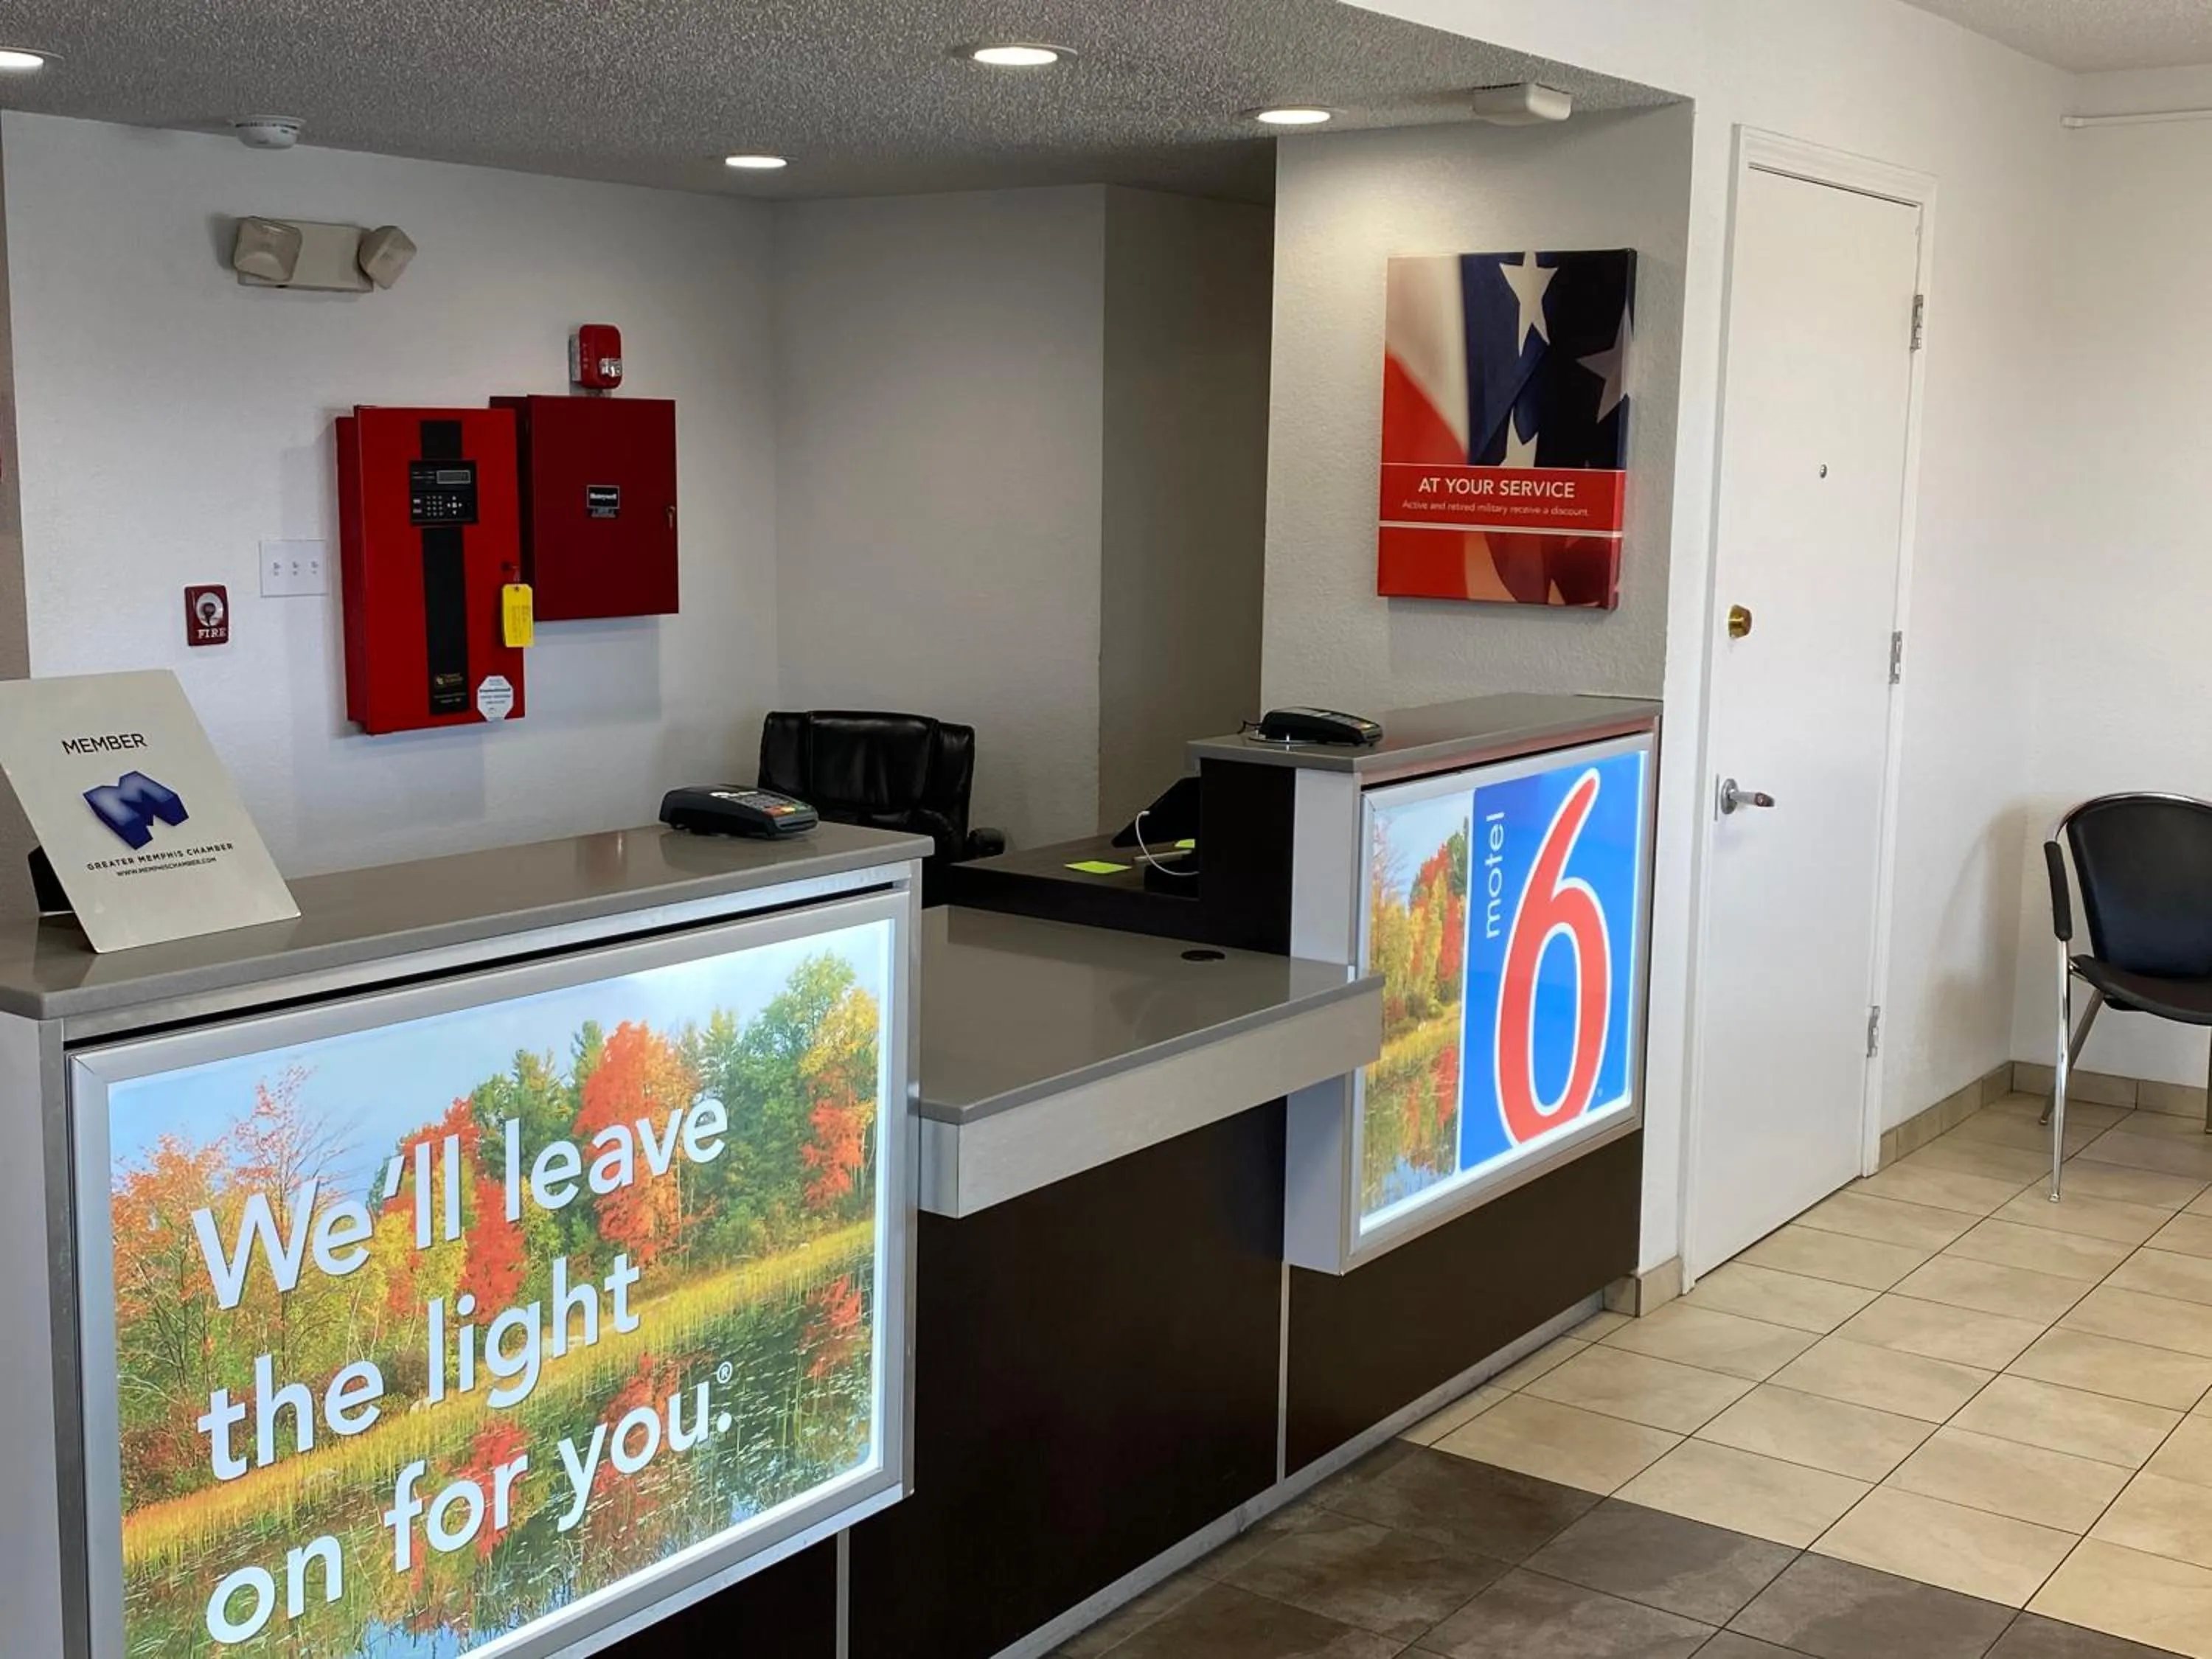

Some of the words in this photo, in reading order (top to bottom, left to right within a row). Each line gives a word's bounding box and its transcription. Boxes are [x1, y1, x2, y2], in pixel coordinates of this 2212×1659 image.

[1402, 500, 1427, 509] Active
[1430, 501, 1445, 509] and
[1447, 502, 1475, 512] retired
[1477, 503, 1507, 515] military
[1510, 506, 1541, 514] receive
[1418, 478, 1441, 493] AT
[1445, 479, 1493, 495] YOUR
[1499, 481, 1575, 498] SERVICE
[198, 627, 226, 639] FIRE
[62, 733, 147, 755] MEMBER
[87, 858, 134, 871] GREATER
[138, 850, 184, 863] MEMPHIS
[187, 843, 234, 856] CHAMBER
[1485, 812, 1504, 938] motel
[1495, 768, 1611, 1145] 6
[505, 1097, 728, 1222] leave
[198, 1353, 385, 1481] the
[427, 1253, 641, 1409] light
[206, 1534, 344, 1645] on
[384, 1454, 529, 1572] for
